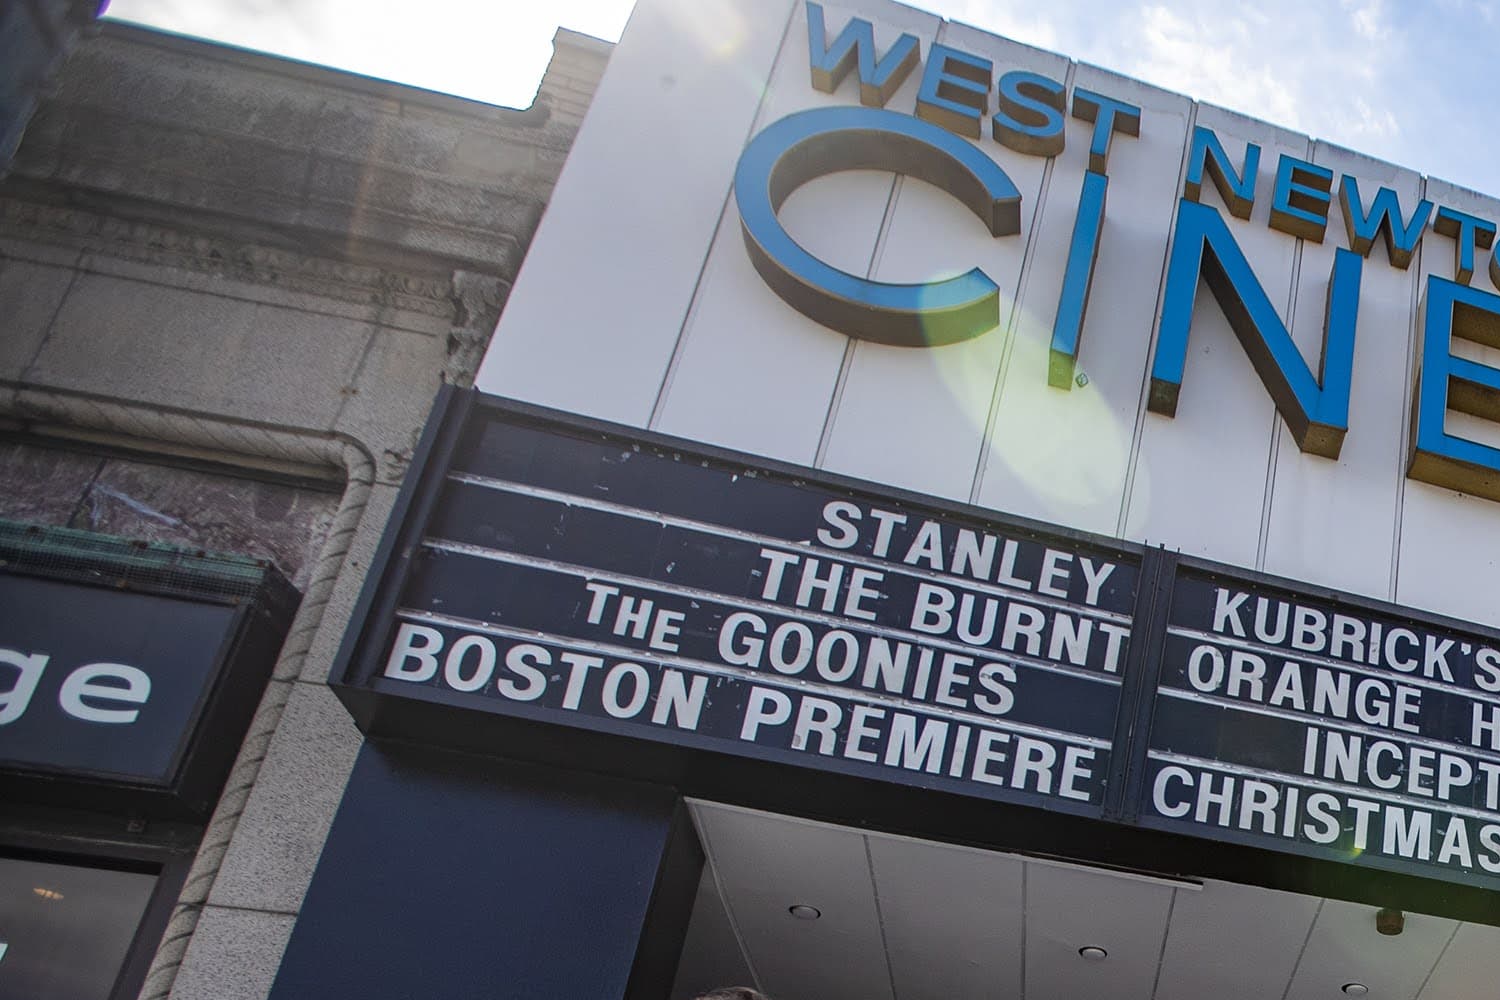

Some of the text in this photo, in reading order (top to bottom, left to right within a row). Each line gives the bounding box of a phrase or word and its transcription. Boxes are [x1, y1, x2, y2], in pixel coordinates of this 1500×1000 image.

[807, 3, 1141, 172] WEST
[817, 501, 1116, 606] STANLEY
[383, 622, 709, 731] BOSTON
[740, 686, 1096, 801] PREMIERE
[586, 582, 686, 652] THE
[718, 612, 1017, 715] GOONIES
[760, 548, 884, 621] THE
[910, 583, 1131, 673] BURNT
[1188, 645, 1422, 734] ORANGE
